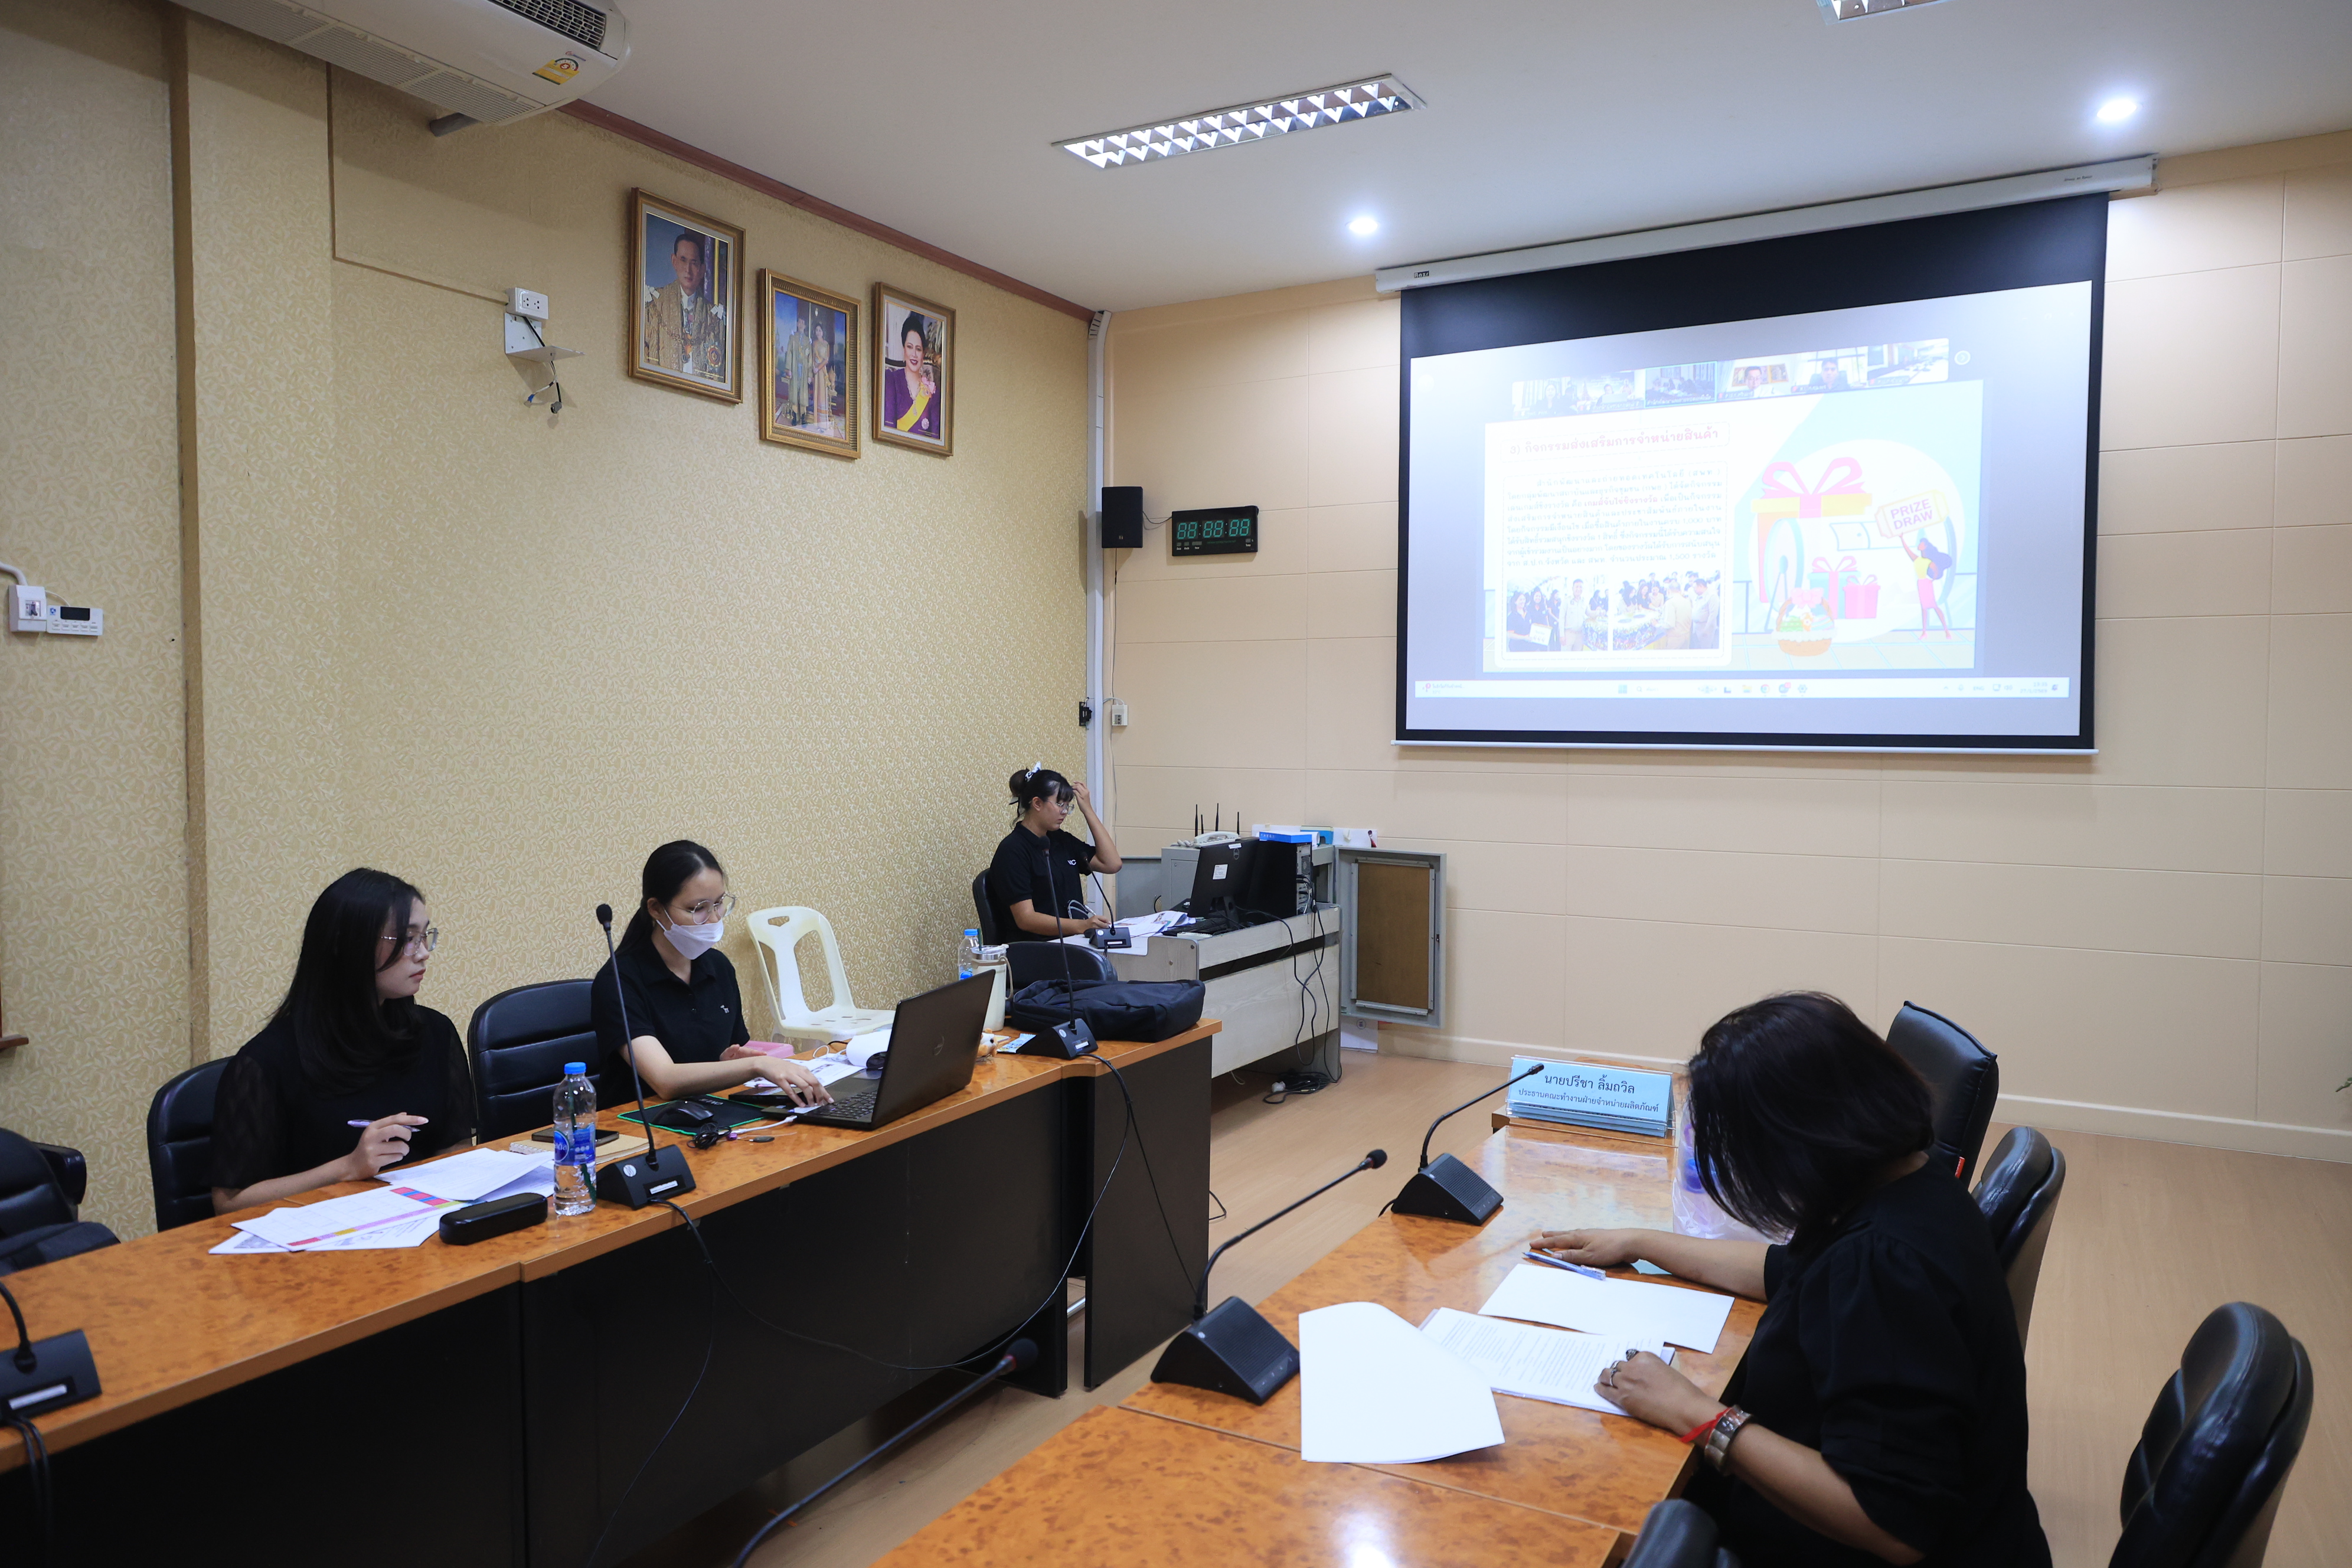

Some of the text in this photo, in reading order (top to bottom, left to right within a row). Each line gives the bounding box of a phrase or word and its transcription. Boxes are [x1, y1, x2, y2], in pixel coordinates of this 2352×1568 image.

[1509, 425, 1719, 455] 3) กิจกรรมส่งเสริมการจำหน่ายสินค้า
[1890, 499, 1932, 519] PRIZE
[1893, 509, 1932, 530] DRAW
[1544, 1073, 1635, 1095] นายปรีชา ลิ้มถวิล
[1518, 1088, 1659, 1113] ประธานคณะทำงานฝ่ายจำหน่ายผลิตภัณฑ์
